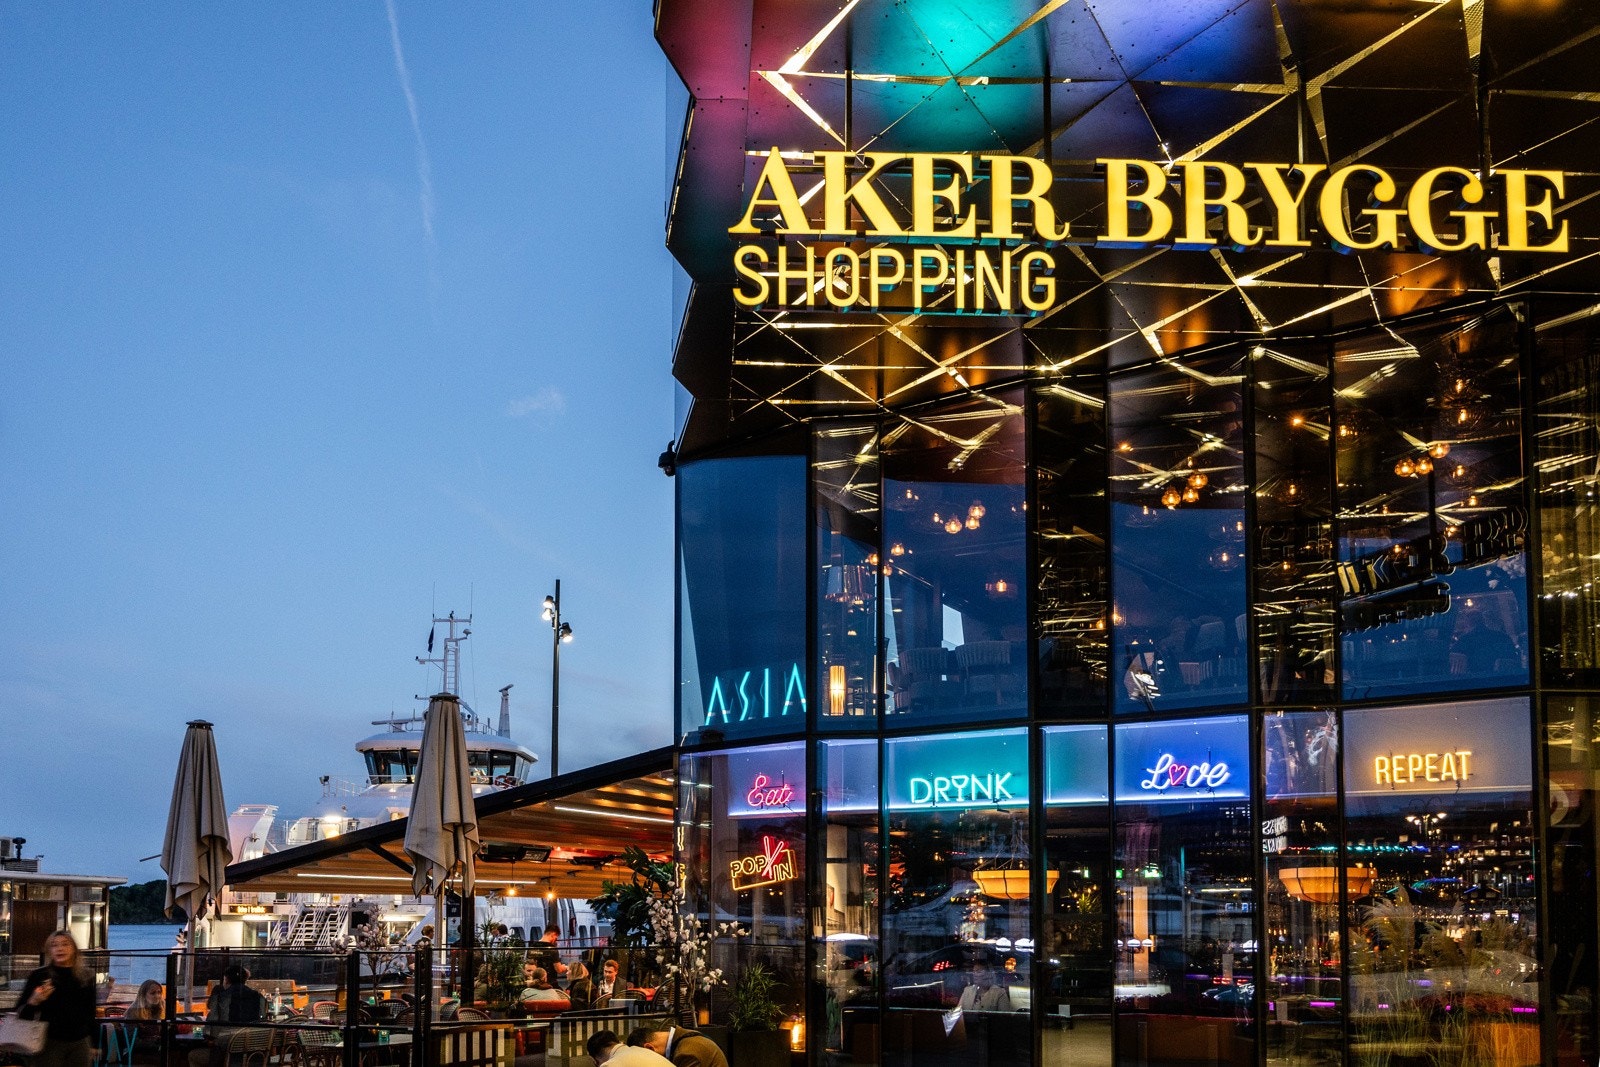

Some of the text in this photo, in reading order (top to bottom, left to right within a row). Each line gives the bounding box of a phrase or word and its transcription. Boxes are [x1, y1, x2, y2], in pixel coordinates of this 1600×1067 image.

[728, 146, 1569, 252] AKER BRYGGE
[732, 245, 1056, 311] SHOPPING
[705, 662, 807, 726] ASIA
[747, 774, 794, 807] Eat
[1375, 751, 1472, 785] REPEAT
[730, 855, 769, 878] POP
